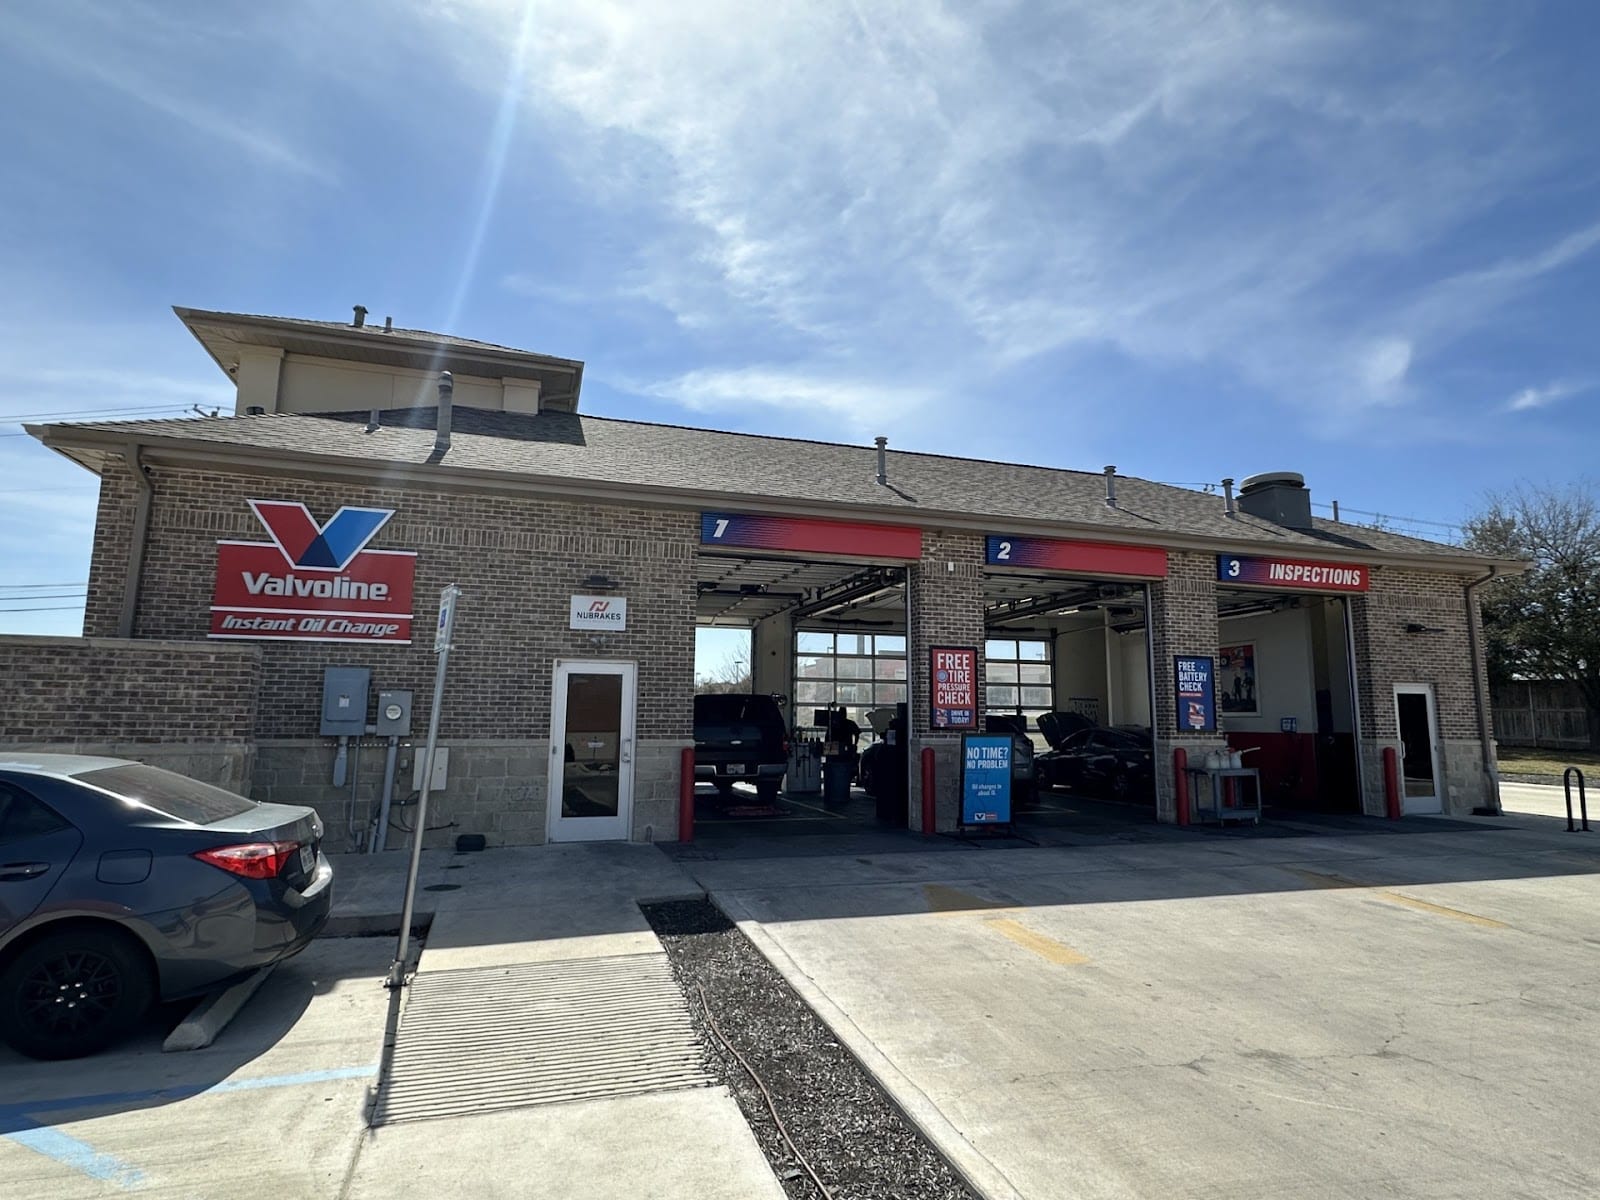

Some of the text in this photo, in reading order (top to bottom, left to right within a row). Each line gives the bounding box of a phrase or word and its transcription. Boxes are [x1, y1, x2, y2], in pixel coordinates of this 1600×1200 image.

[713, 519, 730, 538] 1
[997, 541, 1011, 560] 2
[1228, 560, 1361, 586] 3 INSPECTIONS
[241, 571, 389, 601] Valvoline
[576, 611, 622, 621] NUBRAKES
[221, 615, 399, 637] Instant Oil Change
[937, 653, 971, 670] FREE
[1178, 661, 1196, 672] FREE
[948, 669, 971, 683] TIRE
[1178, 671, 1208, 682] BATTERY
[937, 682, 971, 692] PRESSURE
[1179, 681, 1203, 692] CHECK
[937, 691, 971, 705] CHECK
[966, 746, 1009, 760] NO TIME?
[966, 759, 1008, 769] NO PROBLEM
